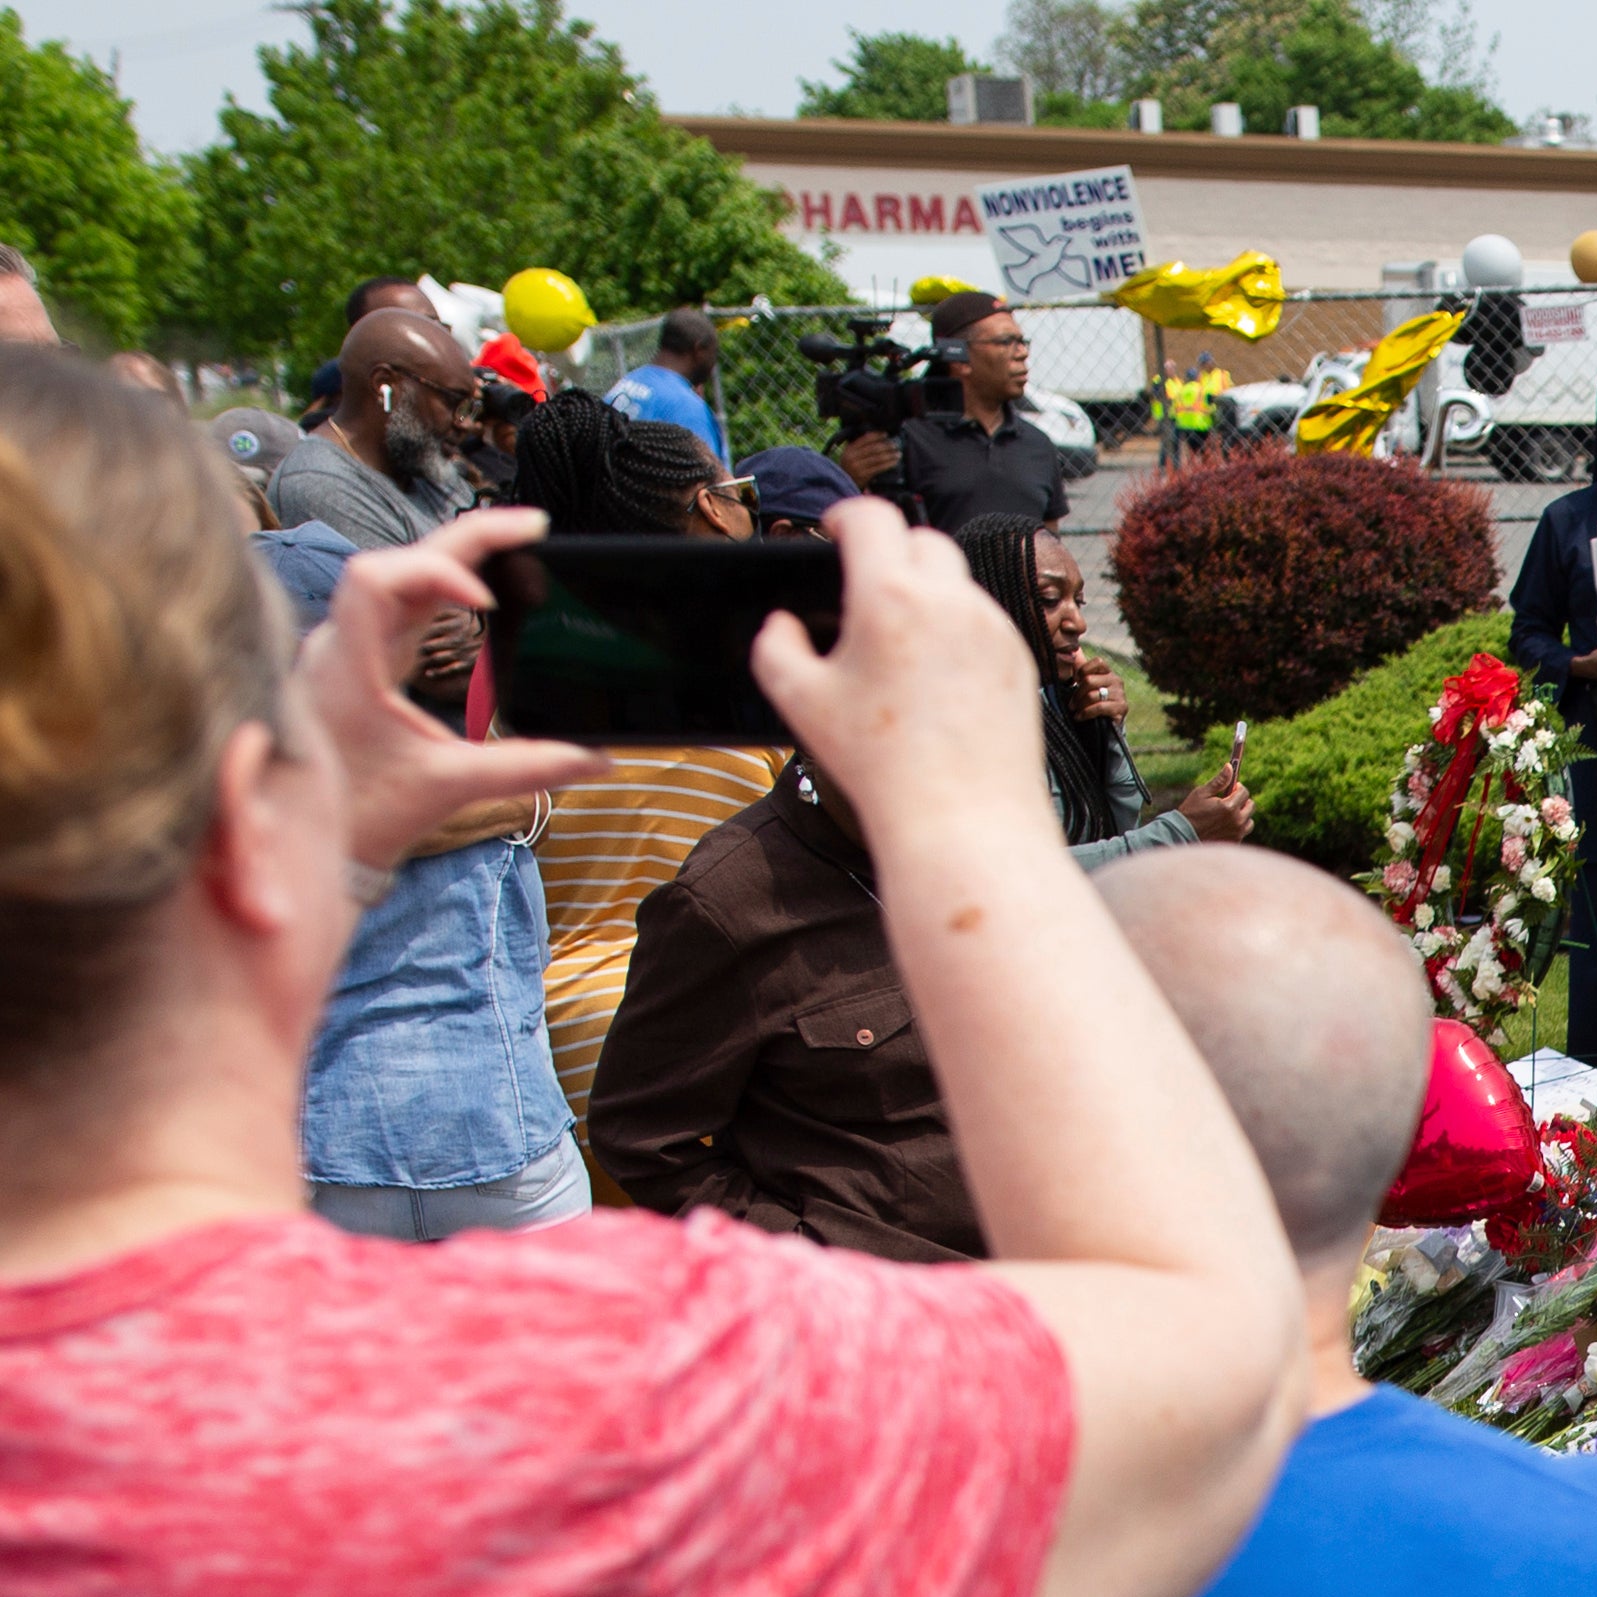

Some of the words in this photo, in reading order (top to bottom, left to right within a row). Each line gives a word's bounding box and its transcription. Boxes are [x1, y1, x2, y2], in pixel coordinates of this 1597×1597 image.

[981, 175, 1130, 218] NONVIOLENCE
[1060, 209, 1135, 232] begins
[1092, 229, 1141, 249] with
[1093, 251, 1147, 282] ME!
